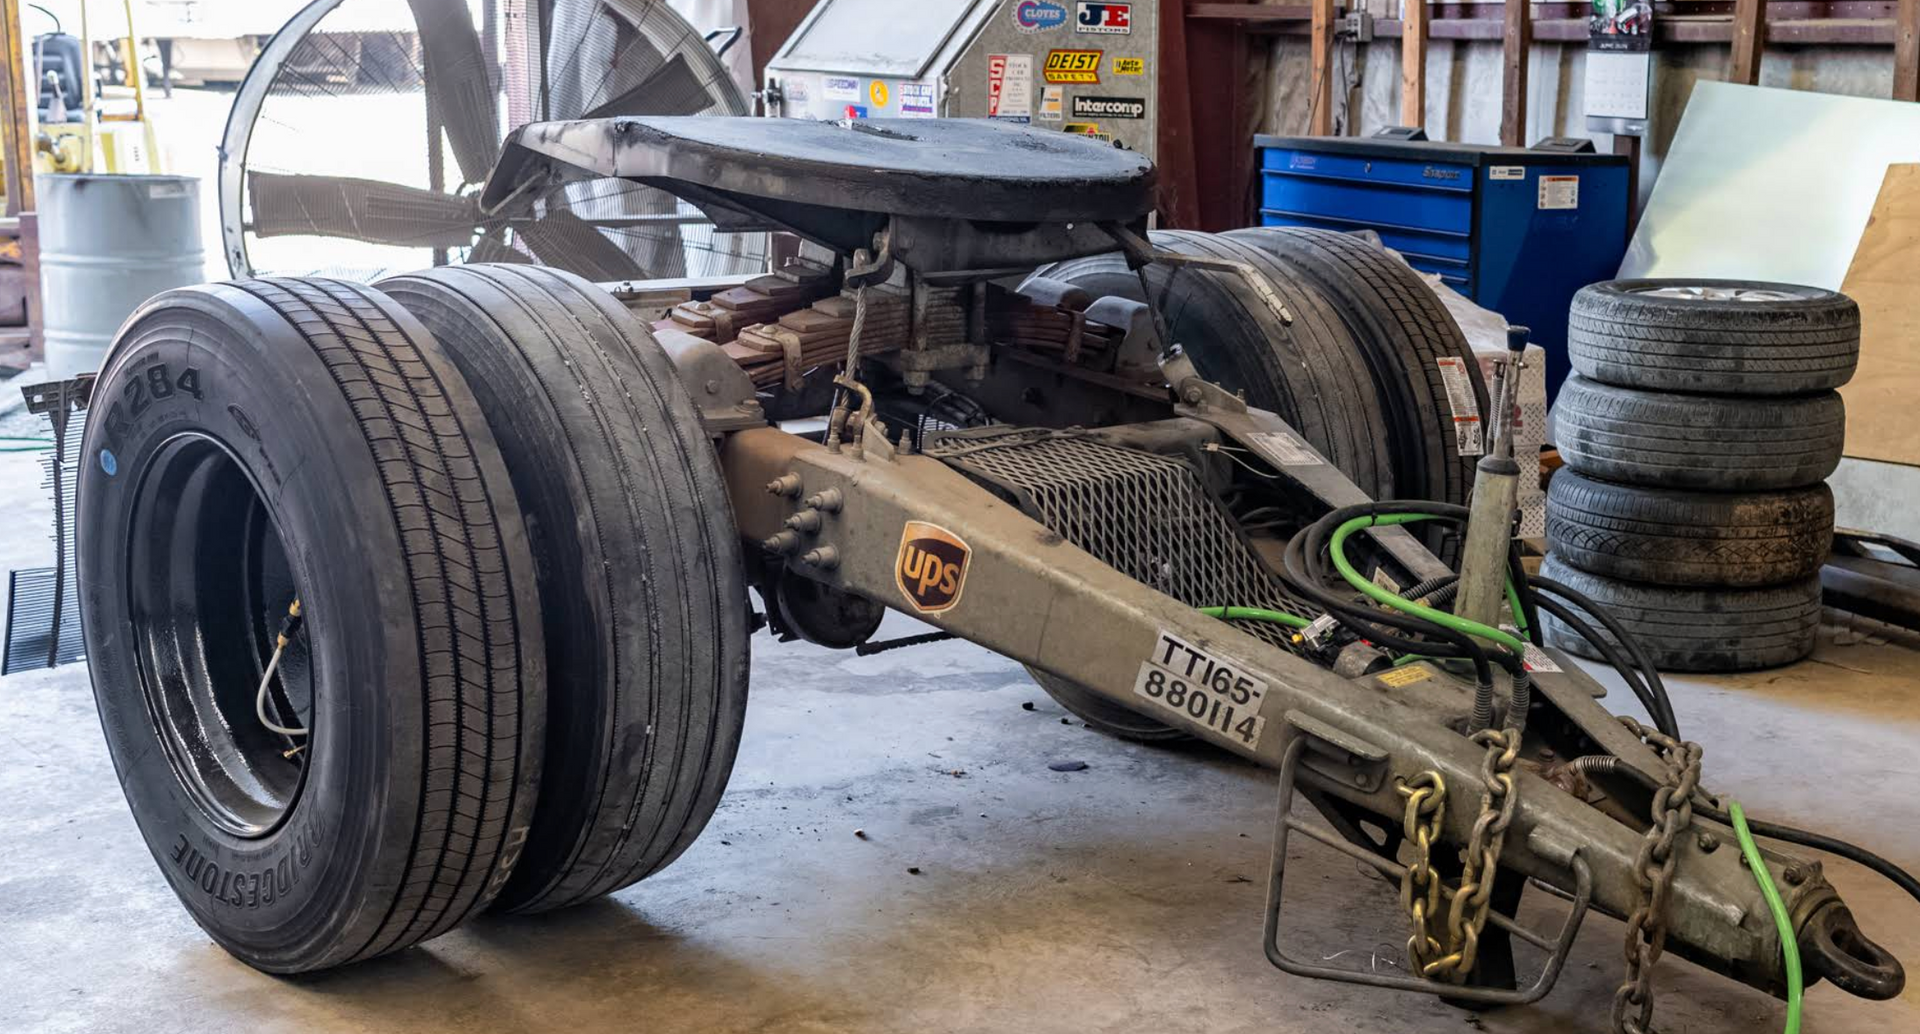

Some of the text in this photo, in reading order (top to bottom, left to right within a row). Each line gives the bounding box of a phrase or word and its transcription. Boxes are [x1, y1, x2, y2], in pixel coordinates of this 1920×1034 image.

[1025, 9, 1061, 19] CLOYES
[1078, 3, 1129, 27] JE
[1049, 54, 1097, 69] DEIST
[1048, 72, 1093, 80] SAFETY
[1075, 97, 1143, 117] Intercomp
[104, 362, 205, 455] R284
[903, 545, 961, 597] ups
[1144, 669, 1256, 744] 880114
[170, 788, 325, 909] BRIDGESTONE
